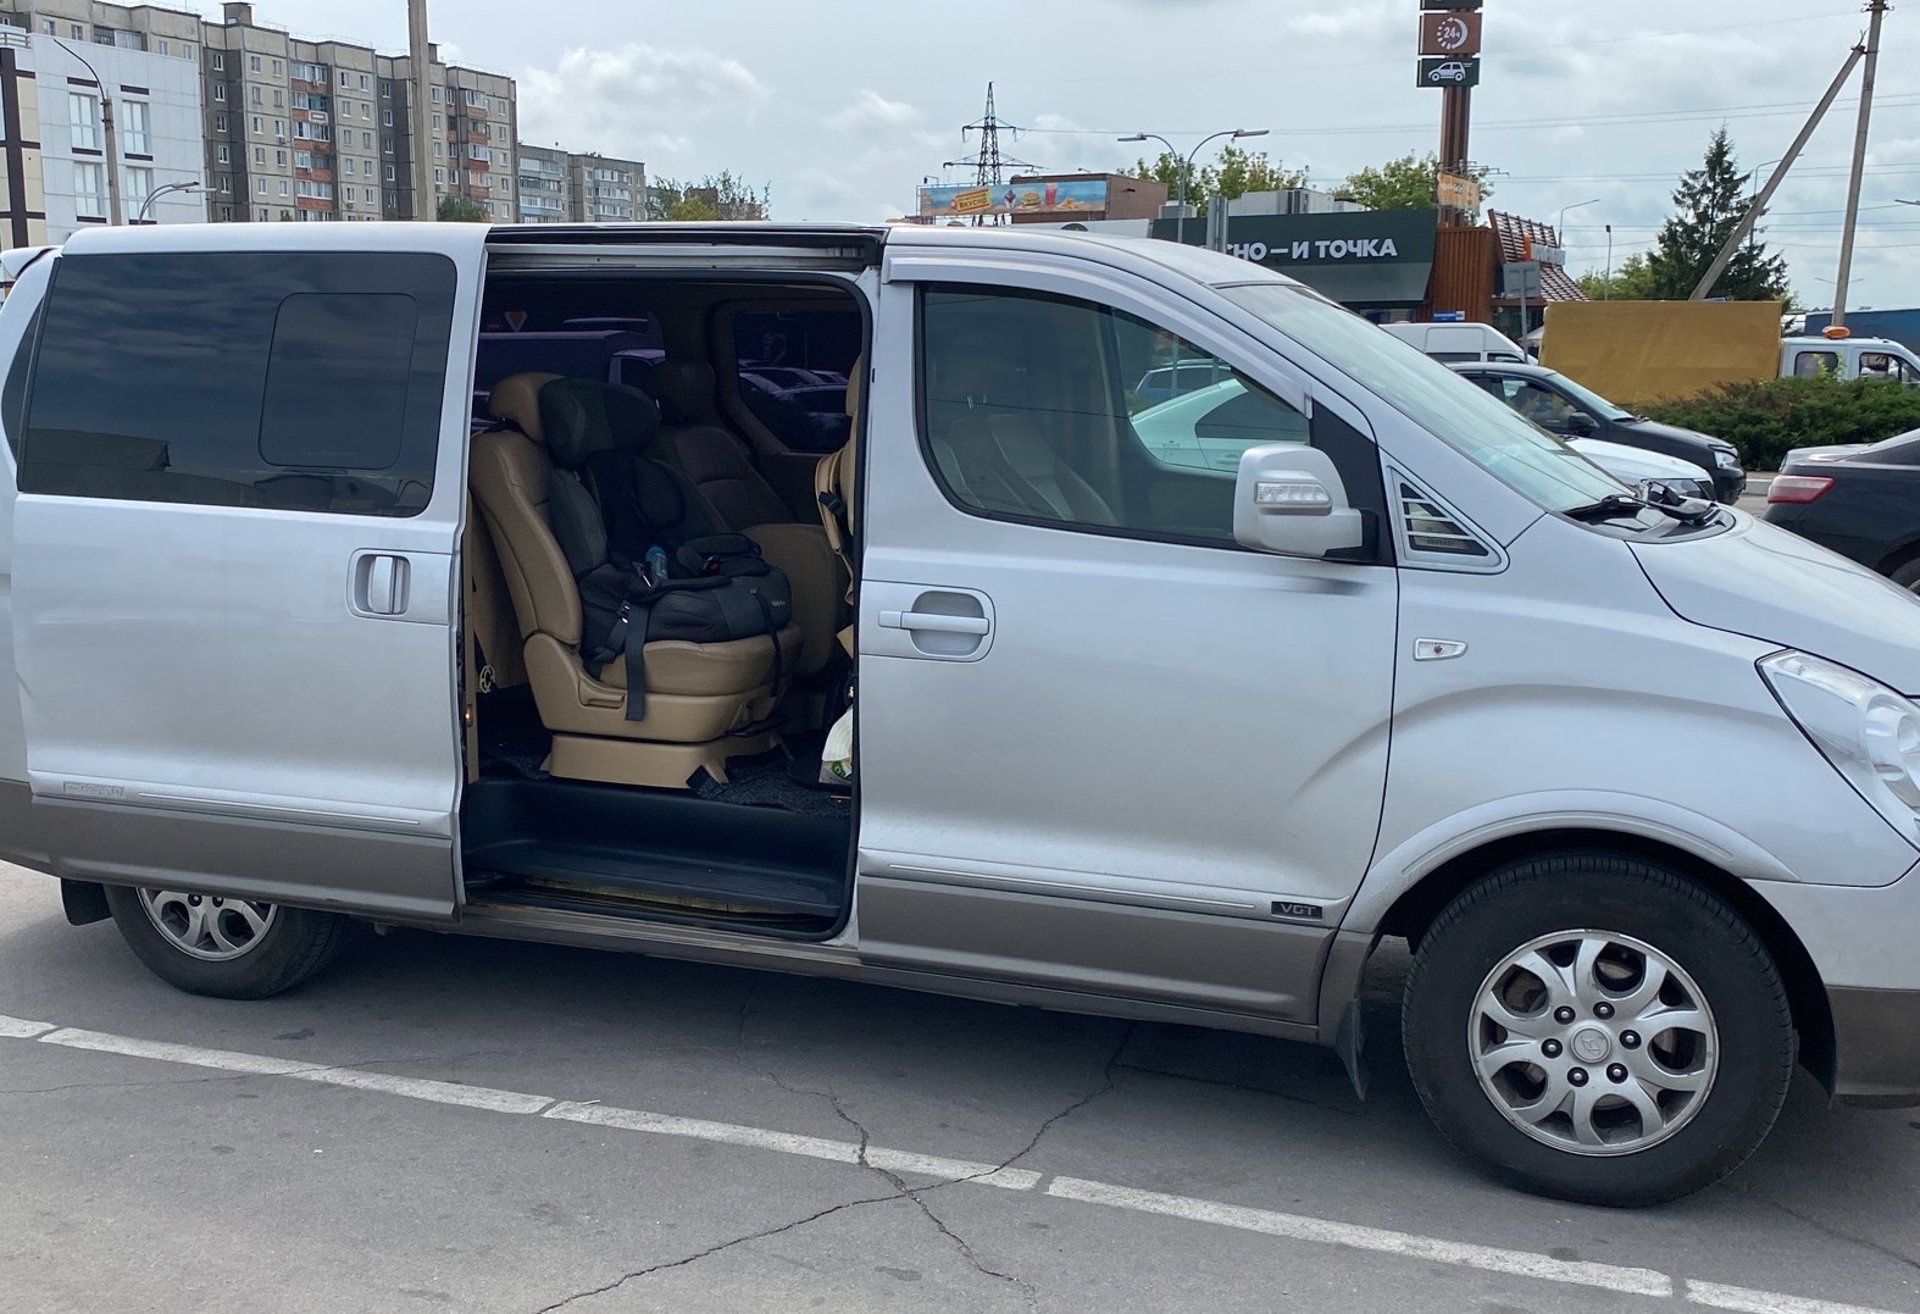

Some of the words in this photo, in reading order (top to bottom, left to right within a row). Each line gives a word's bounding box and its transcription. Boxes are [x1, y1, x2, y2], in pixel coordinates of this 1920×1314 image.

[1292, 241, 1310, 259] И
[1315, 238, 1398, 258] ТОЧКА
[1280, 903, 1316, 916] VGT
